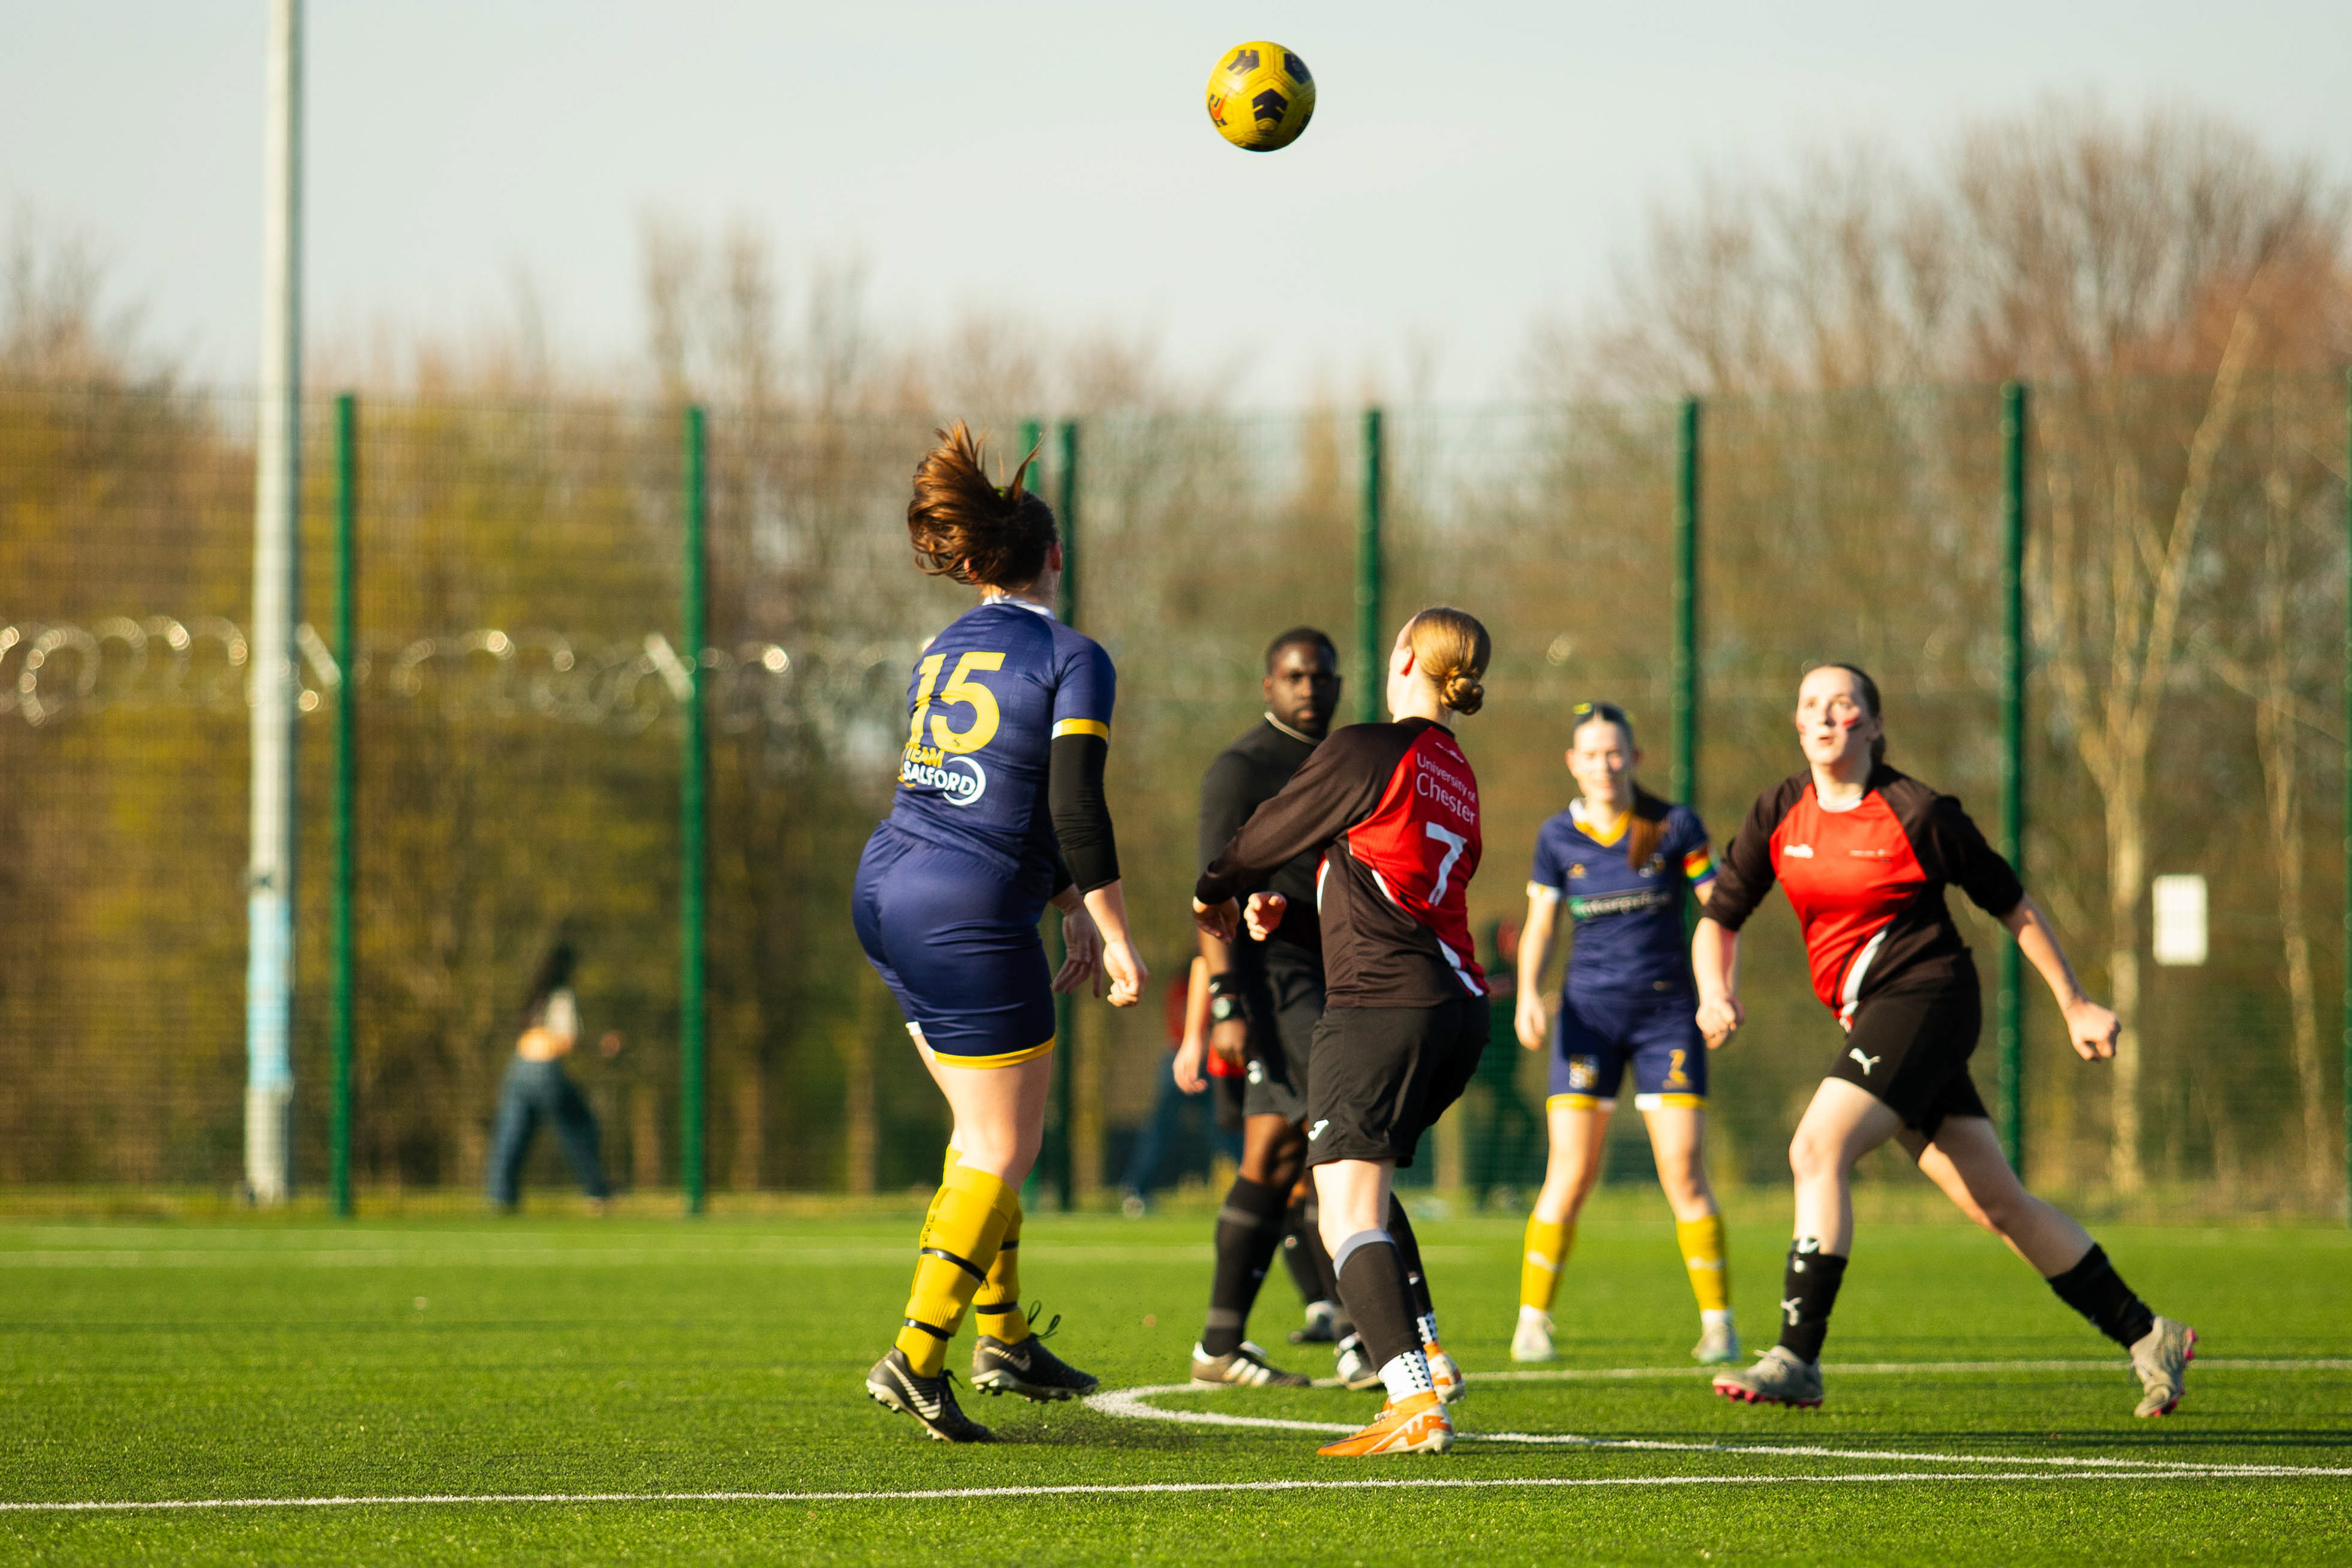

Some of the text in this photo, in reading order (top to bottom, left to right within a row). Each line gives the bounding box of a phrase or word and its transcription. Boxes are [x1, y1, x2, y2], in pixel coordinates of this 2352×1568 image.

[909, 652, 1006, 755] 15
[903, 760, 976, 796] SALFORD
[905, 742, 945, 769] TEAM
[1417, 752, 1468, 796] University
[1468, 791, 1476, 803] of
[1416, 772, 1475, 826] Chester
[1426, 821, 1468, 907] 7
